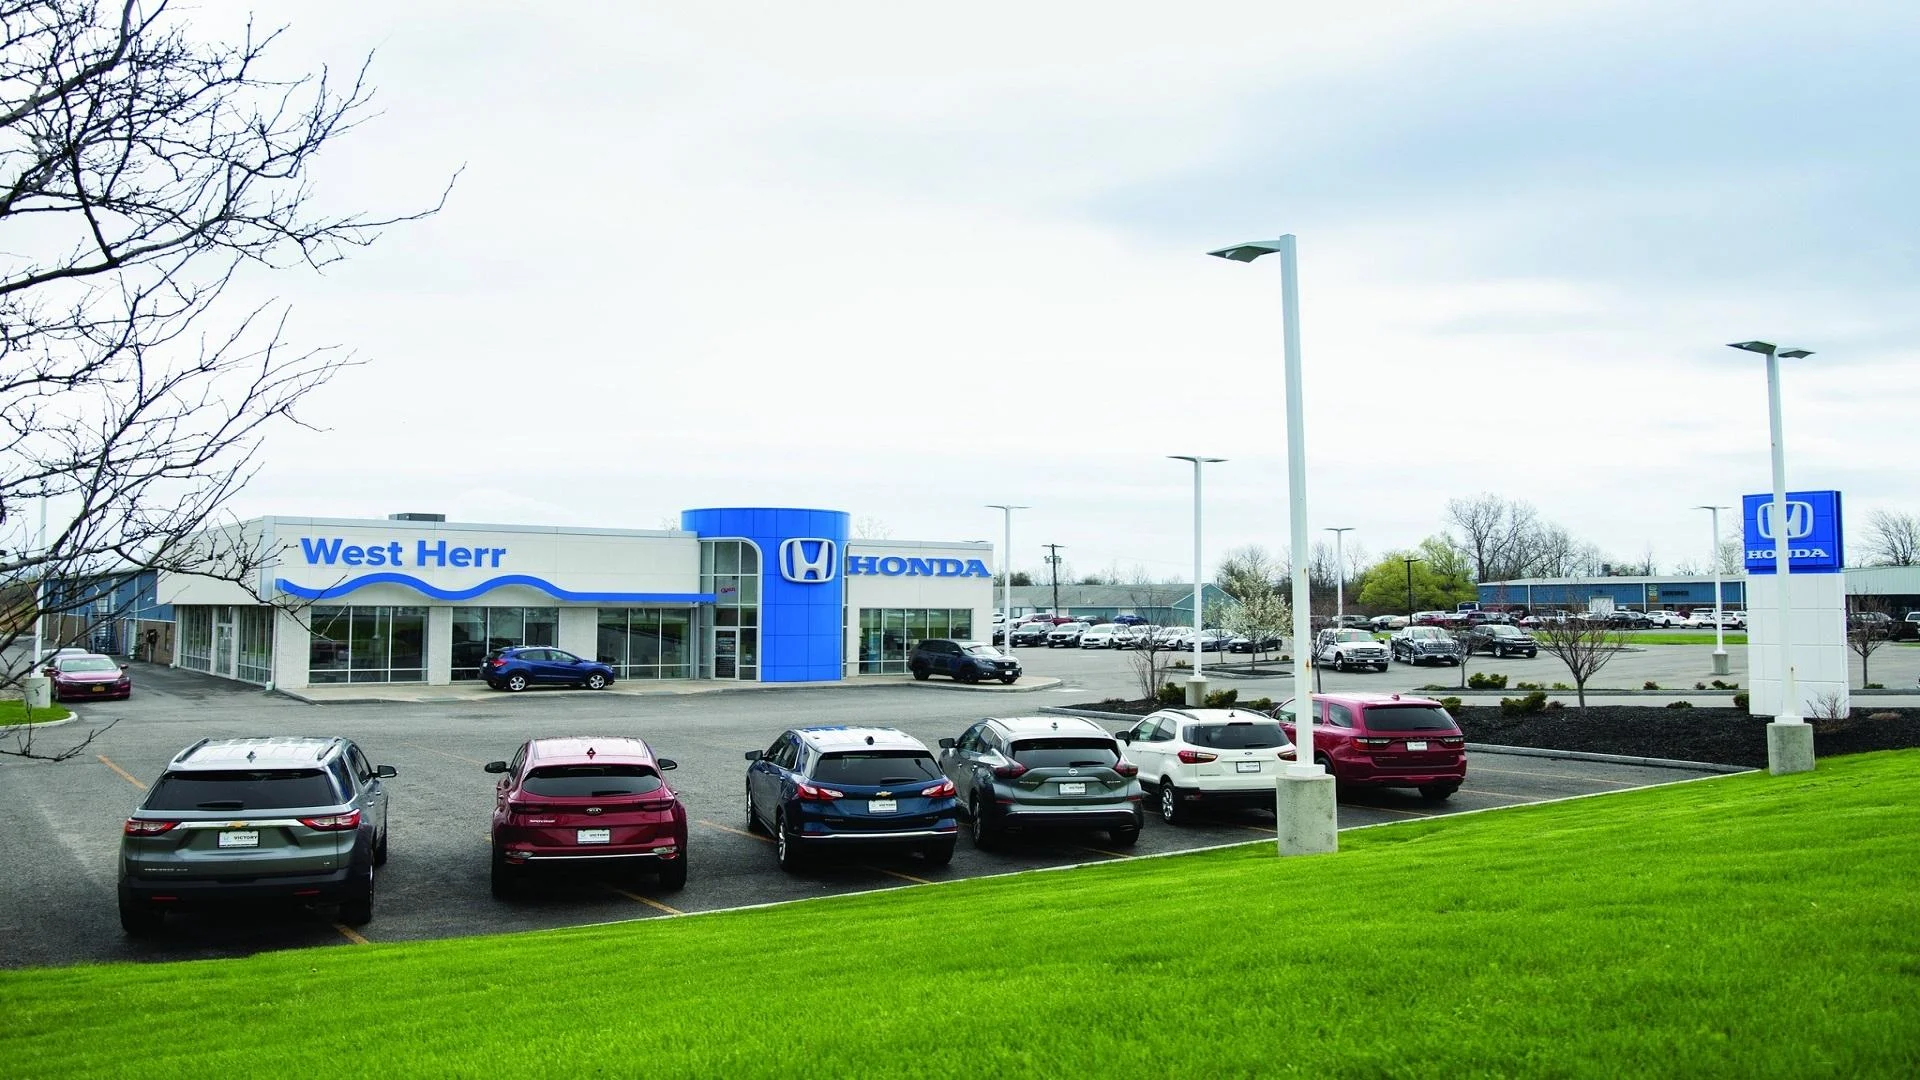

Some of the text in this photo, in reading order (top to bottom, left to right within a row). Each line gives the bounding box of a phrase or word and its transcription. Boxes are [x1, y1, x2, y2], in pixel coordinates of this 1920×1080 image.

[300, 537, 506, 568] West Herr
[848, 555, 992, 578] HONDA
